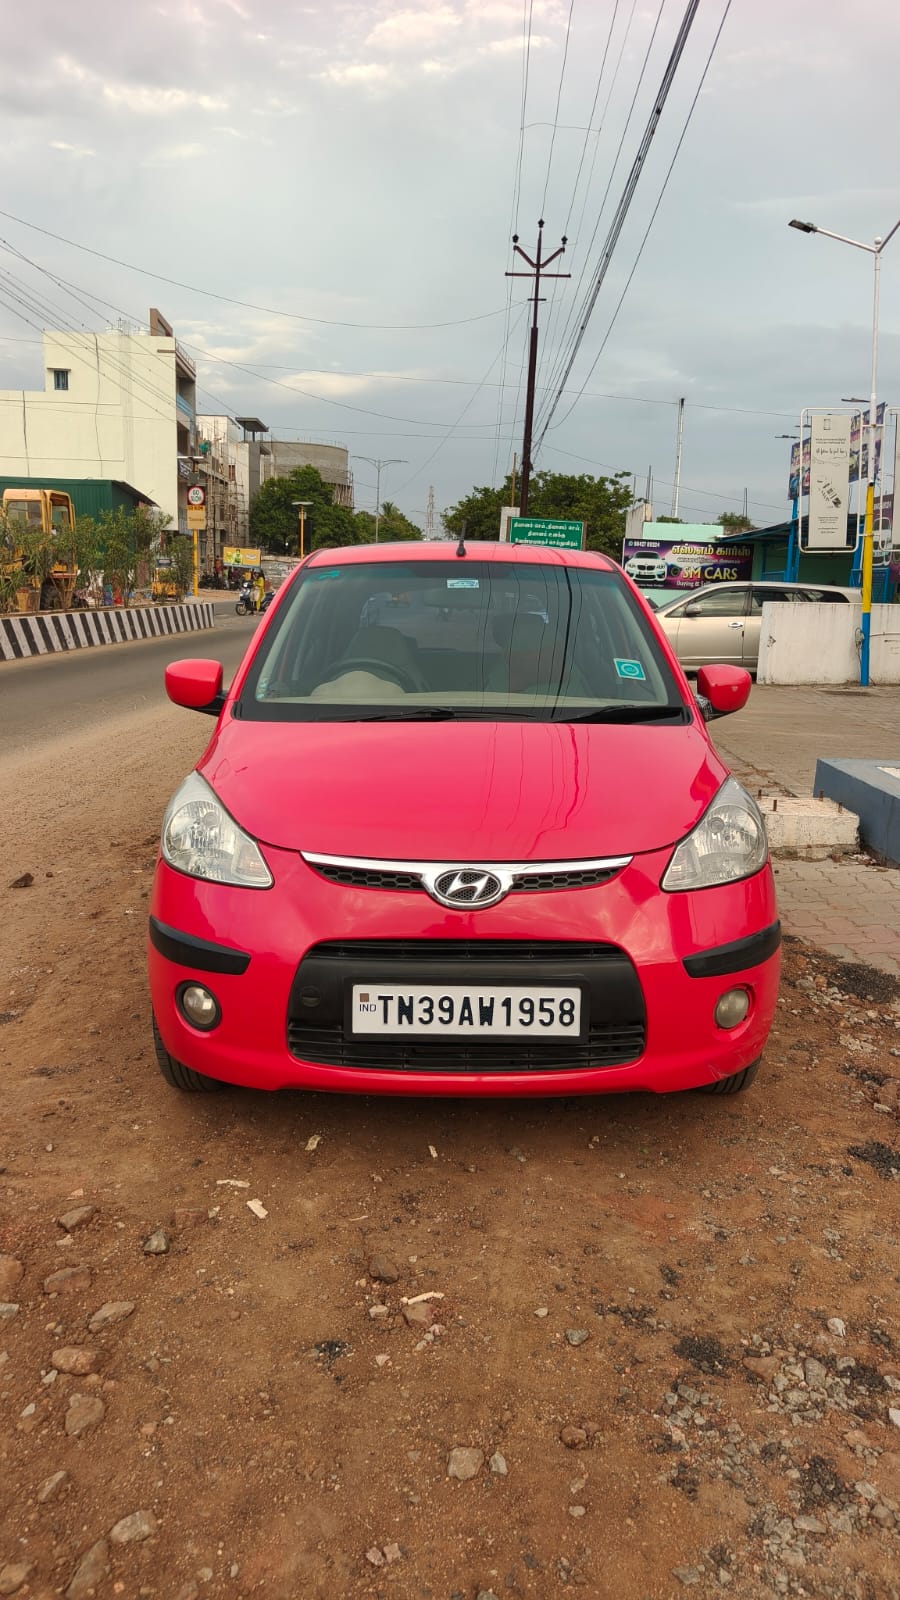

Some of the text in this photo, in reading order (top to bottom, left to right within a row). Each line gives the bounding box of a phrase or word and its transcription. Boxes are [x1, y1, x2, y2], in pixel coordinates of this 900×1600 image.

[682, 565, 738, 580] SM CARS
[359, 994, 576, 1027] IND TN39AW1958
